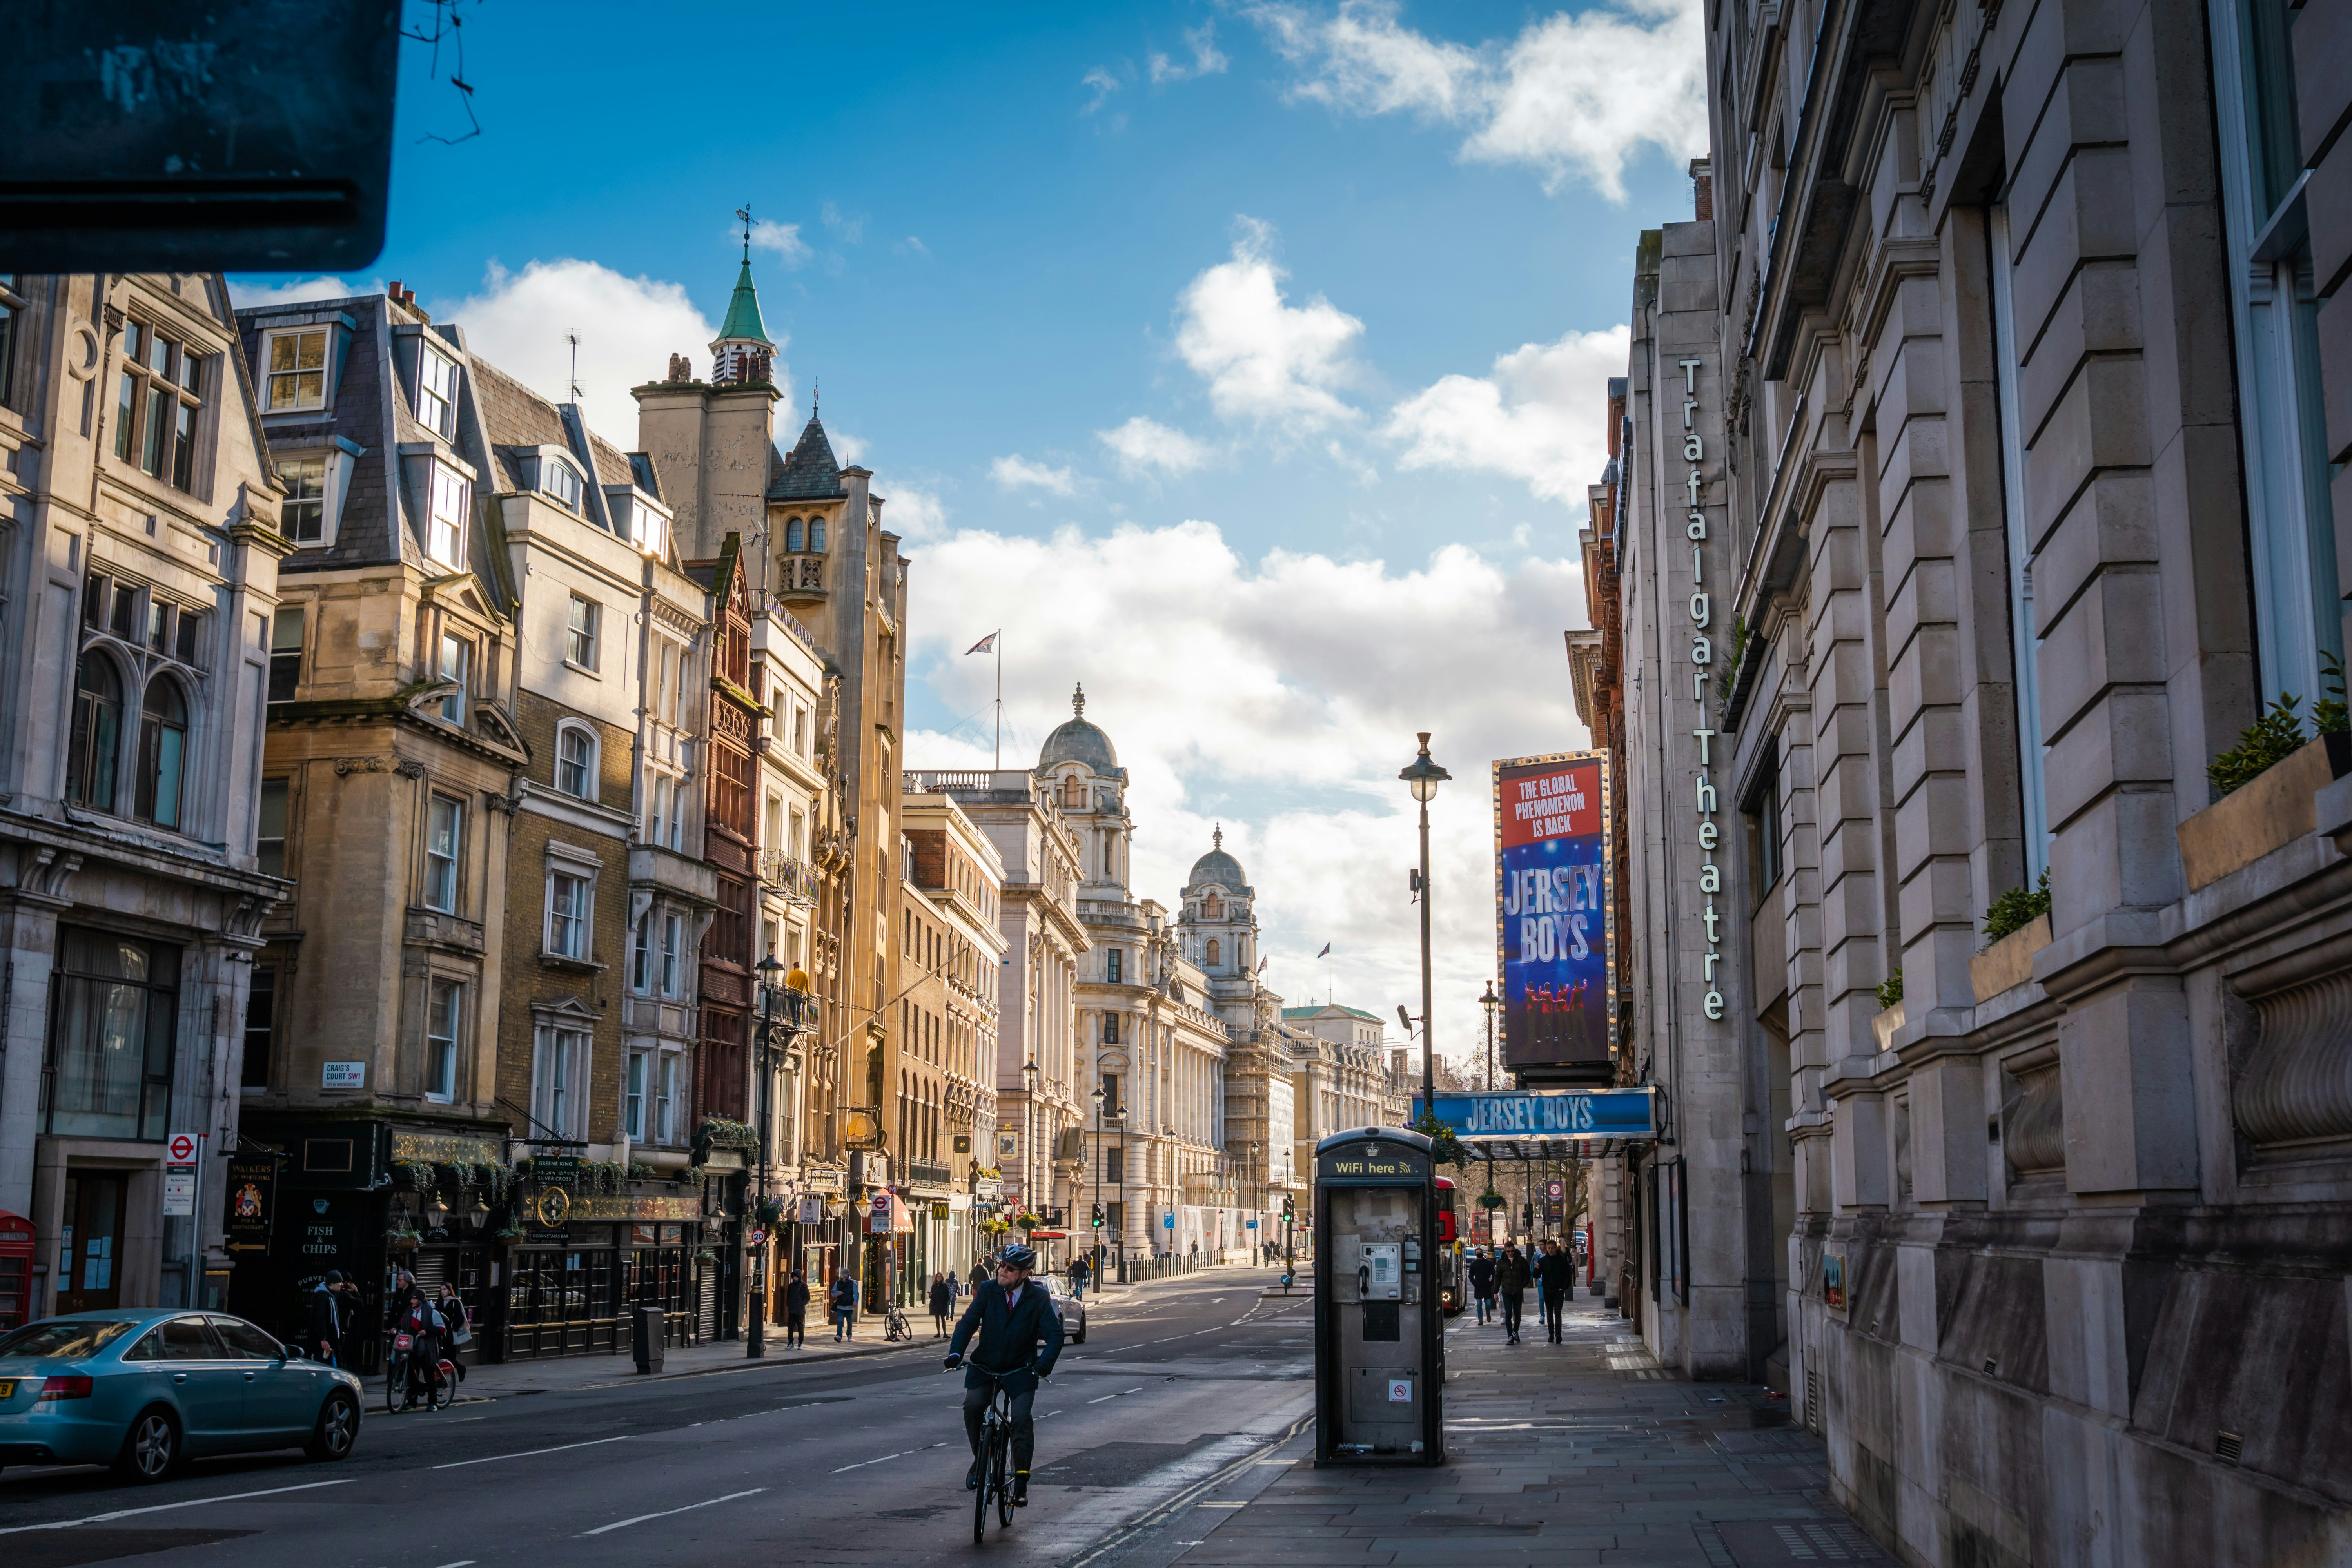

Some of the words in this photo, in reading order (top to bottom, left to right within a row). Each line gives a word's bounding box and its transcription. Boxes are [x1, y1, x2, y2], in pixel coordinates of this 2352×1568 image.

[1679, 358, 1711, 702] Trafalgar
[1519, 781, 1538, 800] THE
[1540, 774, 1578, 797] GLOBAL
[1515, 792, 1585, 820] PHENOMENON
[1532, 821, 1544, 837] IS
[1544, 814, 1572, 836] BACK
[1692, 729, 1724, 1020] Theatre
[1504, 864, 1601, 916] JERSEY
[1521, 914, 1588, 963] BOYS
[1466, 1098, 1537, 1131] JERSEY
[1543, 1097, 1593, 1129] BOYS
[232, 1165, 272, 1173] WALKERS
[1336, 1162, 1363, 1173] WiFi
[1369, 1162, 1395, 1173] here
[307, 1226, 334, 1235] FISH
[302, 1244, 337, 1254] CHIPS
